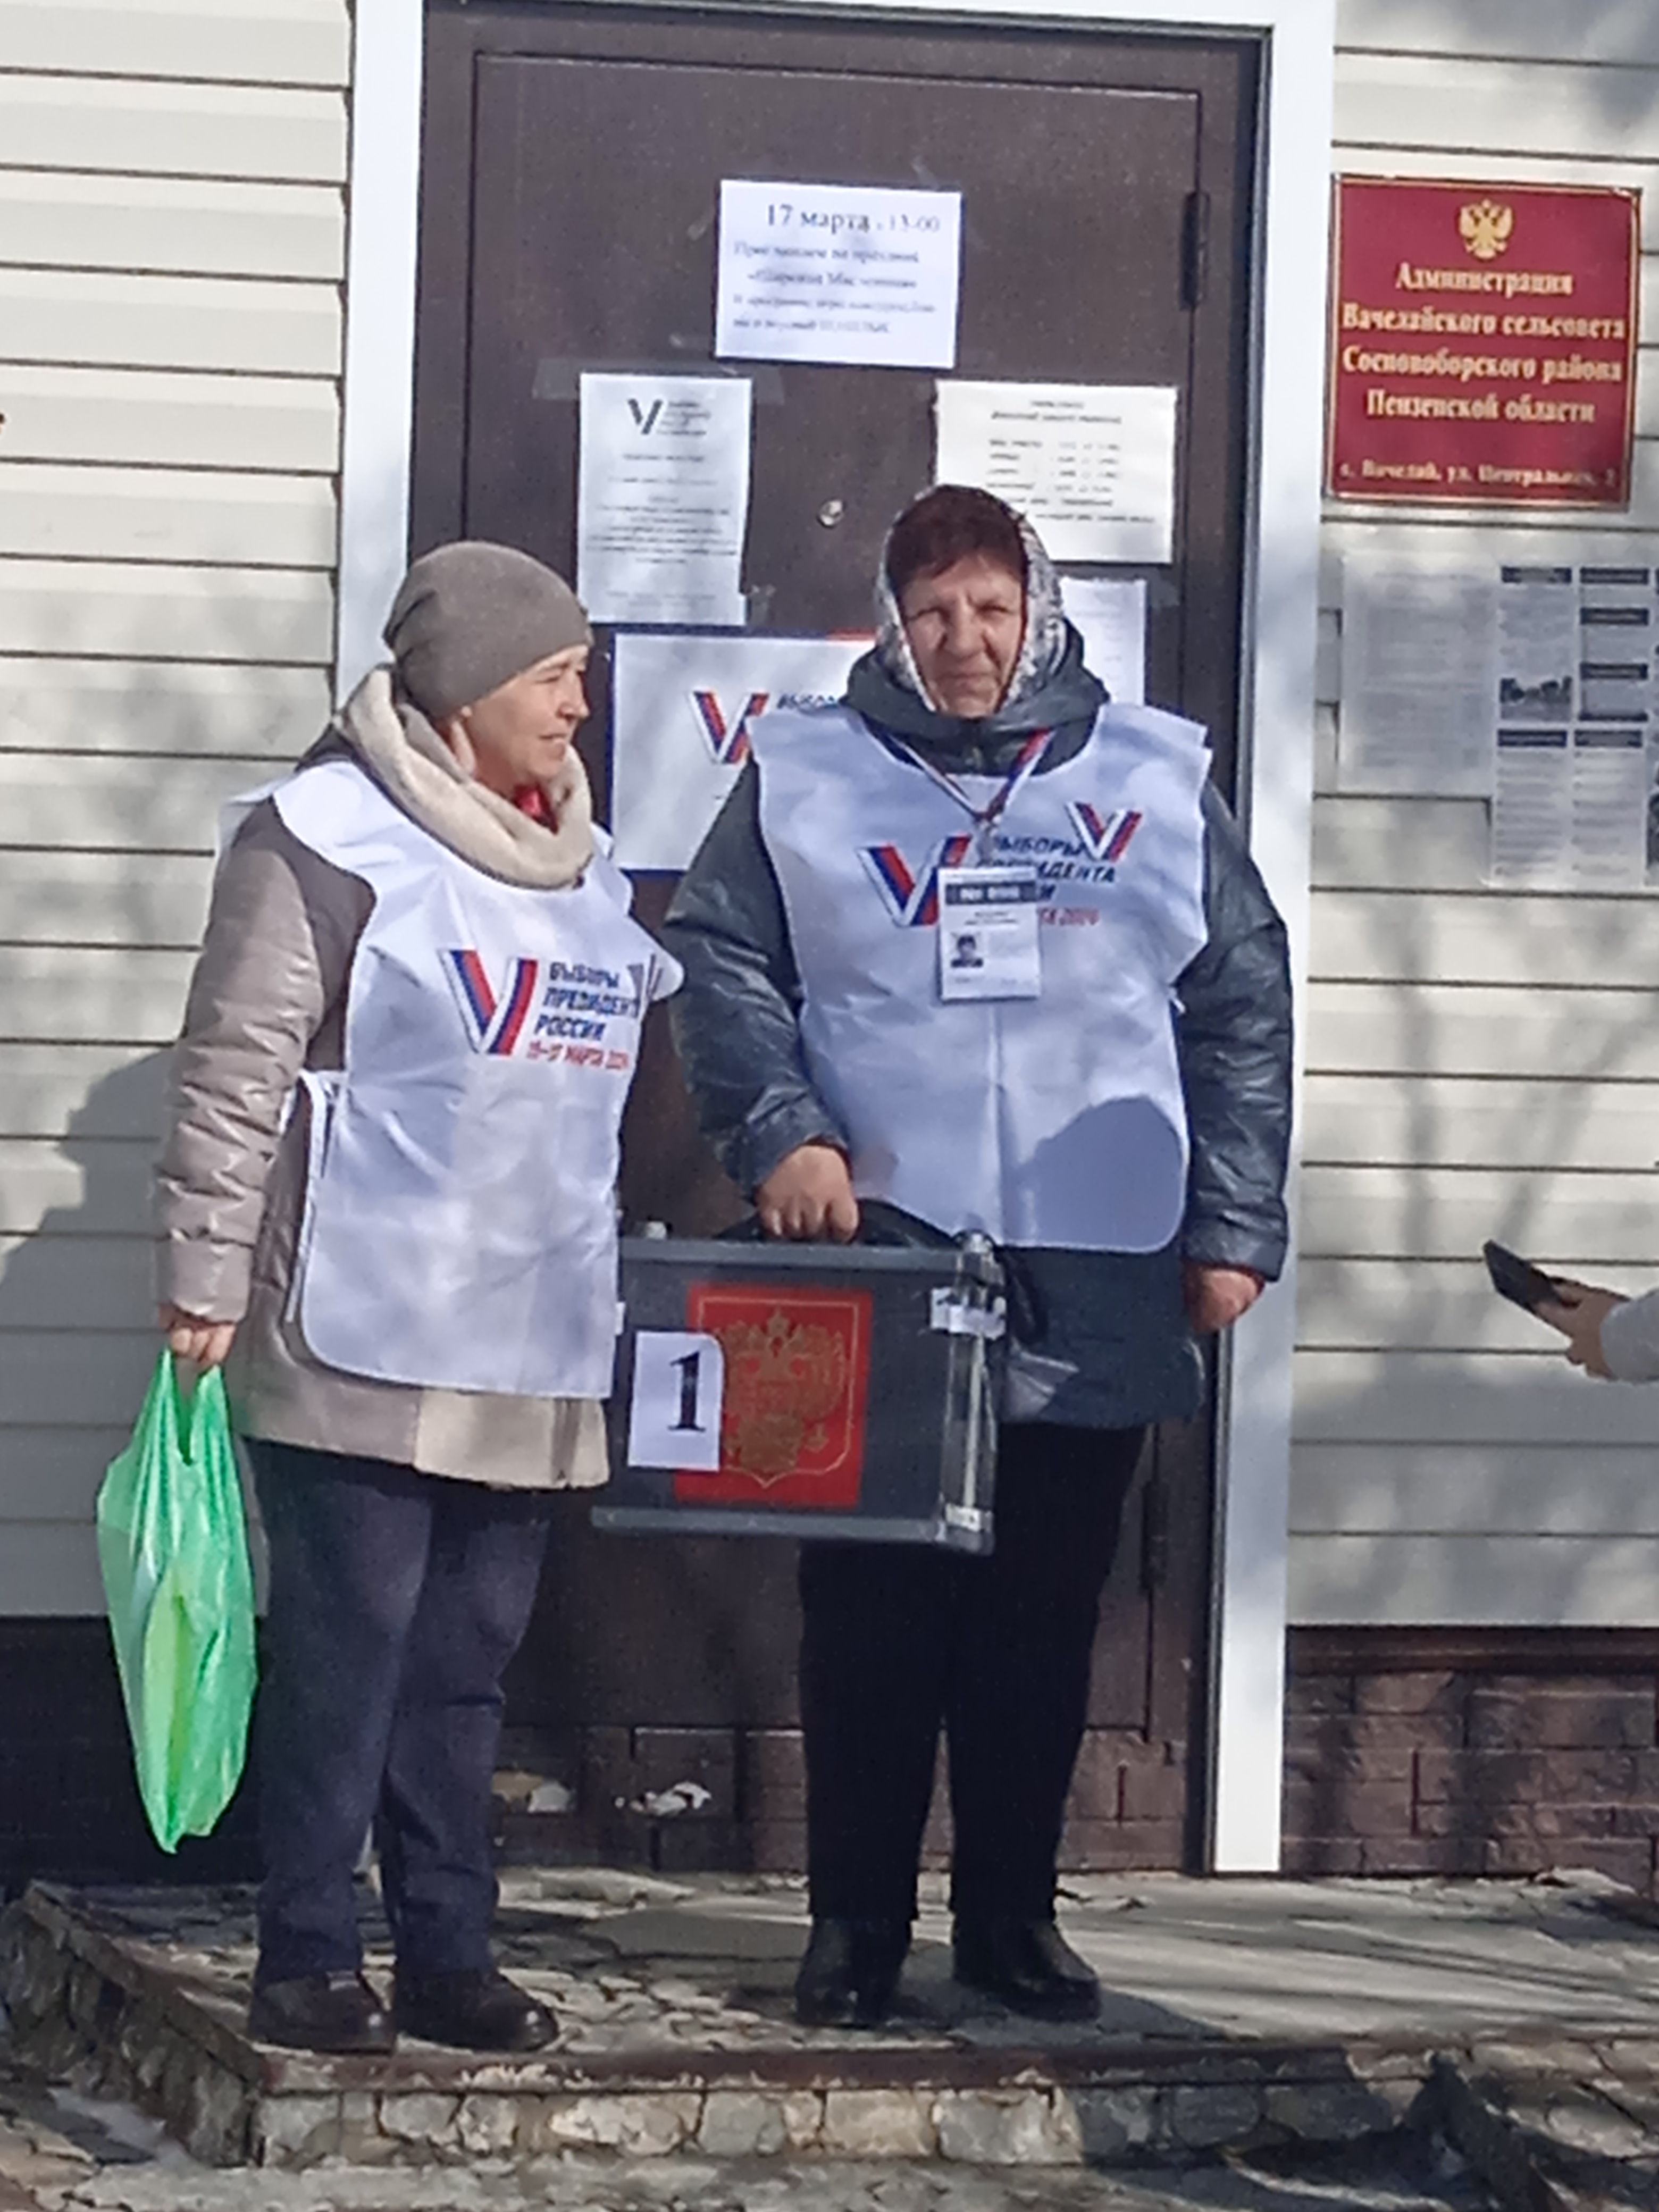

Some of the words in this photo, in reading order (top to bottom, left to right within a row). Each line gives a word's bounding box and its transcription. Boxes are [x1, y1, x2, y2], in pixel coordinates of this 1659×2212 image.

[768, 204, 794, 226] 17
[800, 212, 870, 234] марта
[1395, 262, 1573, 299] Администрация
[1342, 303, 1496, 334] Вачелайского
[1502, 315, 1625, 339] сельсовета
[1343, 345, 1537, 382] Сосновоборского
[1542, 354, 1622, 385] района
[1367, 389, 1499, 420] Пензенской
[1504, 393, 1595, 423] области
[550, 961, 619, 988] ВЫБОРЫ
[534, 1013, 606, 1041] РОССИИ
[668, 1350, 707, 1432] 1
